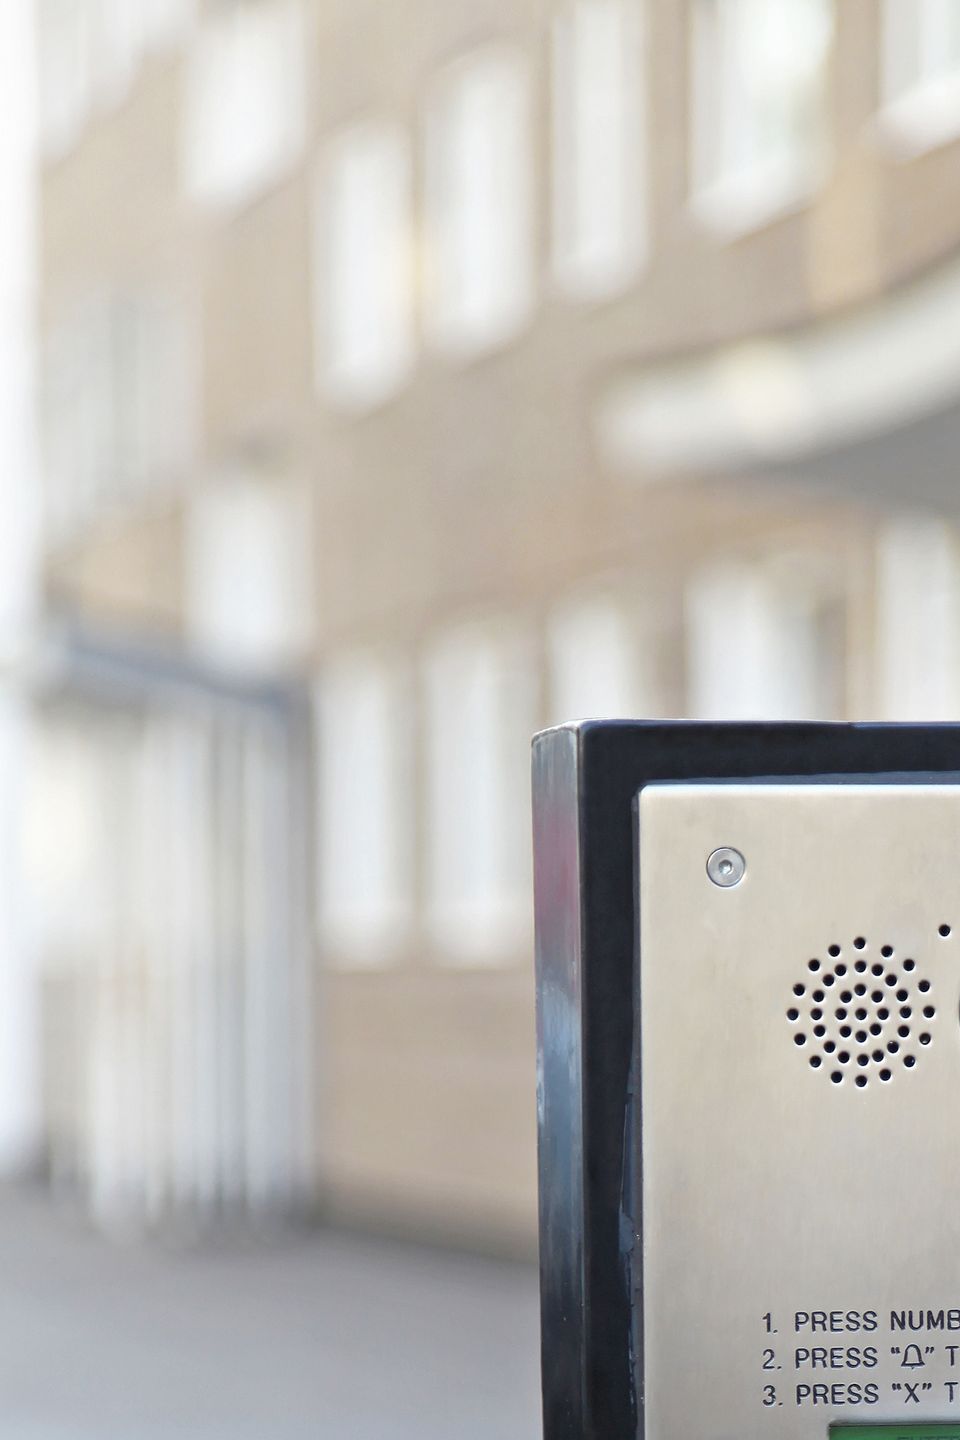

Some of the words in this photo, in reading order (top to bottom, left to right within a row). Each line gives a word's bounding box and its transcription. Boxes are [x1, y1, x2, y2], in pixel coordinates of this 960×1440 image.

[762, 1312, 778, 1334] 1.
[794, 1310, 878, 1332] PRESS
[762, 1349, 782, 1370] 2.
[794, 1347, 878, 1368] PRESS
[763, 1385, 783, 1407] 3.
[796, 1383, 879, 1405] PRESS
